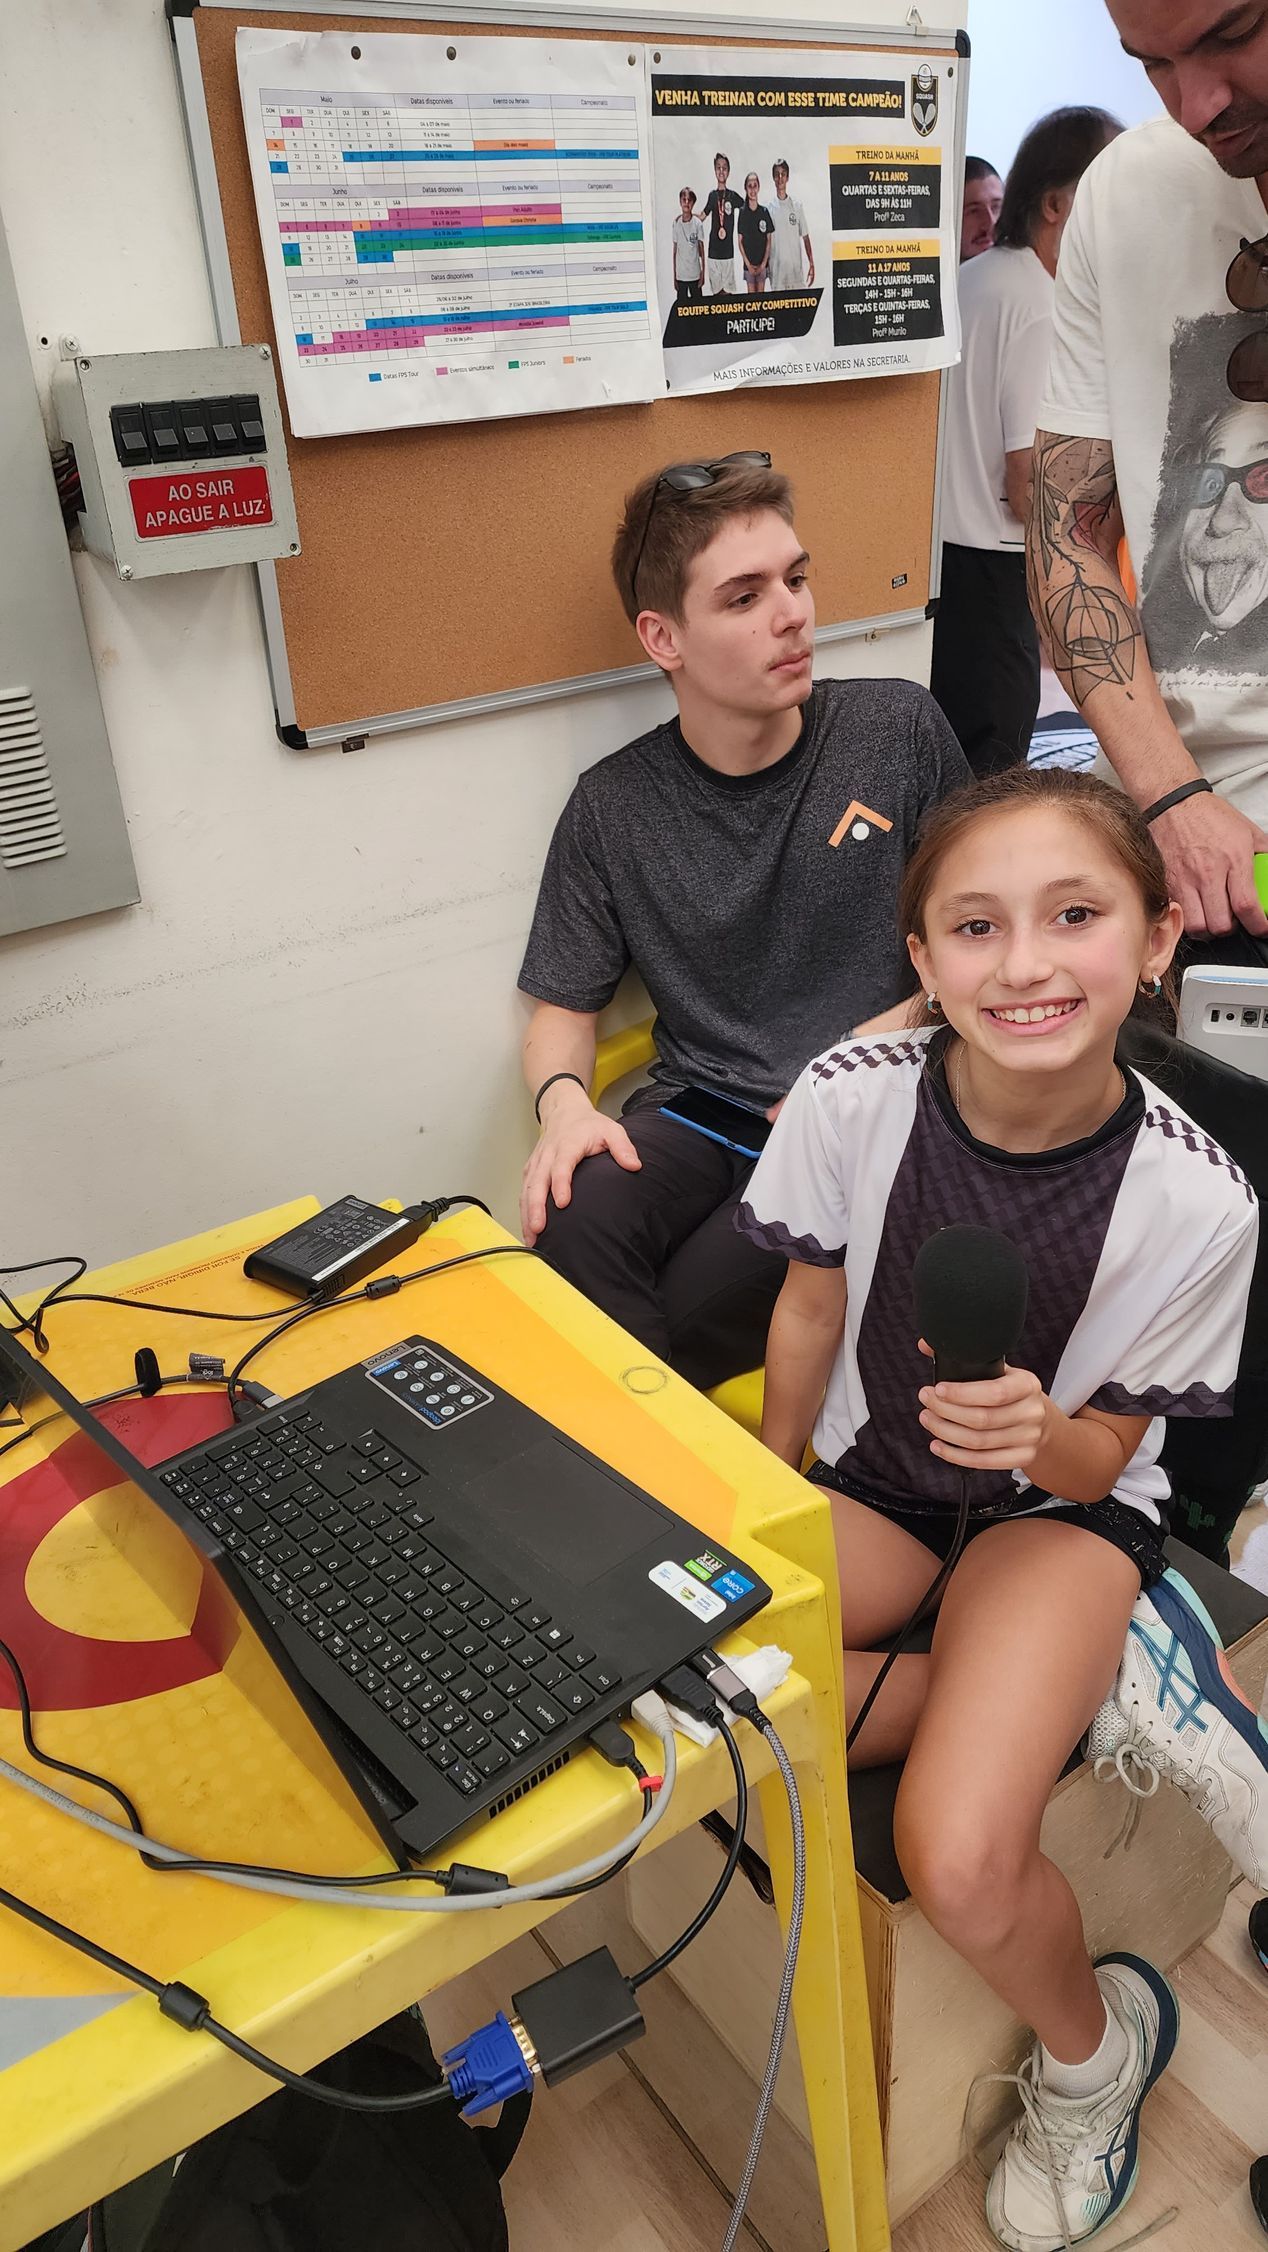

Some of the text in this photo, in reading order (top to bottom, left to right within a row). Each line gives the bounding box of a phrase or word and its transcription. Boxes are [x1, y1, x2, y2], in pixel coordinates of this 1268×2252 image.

[655, 89, 902, 108] VENHA TREINAR COM ESSE TIME CAMPEÃO!
[856, 149, 920, 161] TREINO DA MANHÃ
[869, 171, 909, 182] 7 A 11 ANOS
[842, 184, 877, 196] QUARTAS
[878, 185, 883, 195] E
[865, 198, 880, 209] DAS
[880, 199, 890, 209] 9H
[900, 199, 912, 209] 11H
[890, 212, 905, 222] Zeca
[856, 243, 921, 255] TREINO DA MANHÃ
[867, 261, 911, 273] 11 A 17 ANOS
[837, 273, 936, 288] SEGUNDAS E QUARTAS-FEIRAS,
[865, 289, 879, 300] 14H
[883, 288, 897, 299] 15H
[901, 287, 913, 298] 16H
[677, 297, 818, 317] EQUIPE SQUASH CAY COMPETITIVO
[844, 302, 872, 315] TERÇAS
[873, 302, 878, 312] E
[874, 314, 888, 325] 15H
[892, 313, 905, 324] 16H
[726, 317, 776, 335] PARTICIPE!
[713, 353, 911, 381] MAIS INFORMAÇÕES E VALORES NA SECRETARIA.
[168, 479, 235, 501] AO SAIR
[145, 499, 264, 528] APAGUE A LUZ
[367, 1345, 406, 1366] Lenovo
[373, 1360, 398, 1375] Lenovo
[353, 1541, 361, 1549] L
[402, 1548, 414, 1557] M
[368, 1557, 378, 1565] K
[699, 1552, 723, 1571] RTX
[421, 1565, 432, 1574] N
[441, 1582, 451, 1591] B
[403, 1590, 415, 1599] H
[336, 1599, 346, 1607] 8
[363, 1596, 374, 1604] U
[459, 1601, 470, 1609] V
[423, 1607, 433, 1616] G
[381, 1614, 392, 1622] Y
[480, 1618, 490, 1626] C
[400, 1632, 411, 1641] T
[442, 1628, 454, 1636] F
[501, 1636, 512, 1645] X
[463, 1645, 474, 1654] D
[392, 1654, 402, 1662] 5
[421, 1650, 431, 1660] R
[522, 1656, 533, 1665] Z
[484, 1664, 495, 1674] S
[412, 1673, 421, 1681] 4
[441, 1670, 452, 1680] E
[506, 1684, 517, 1693] A
[432, 1694, 442, 1703] 3
[459, 1688, 472, 1700] W
[453, 1714, 464, 1723] 2
[483, 1710, 494, 1720] Q
